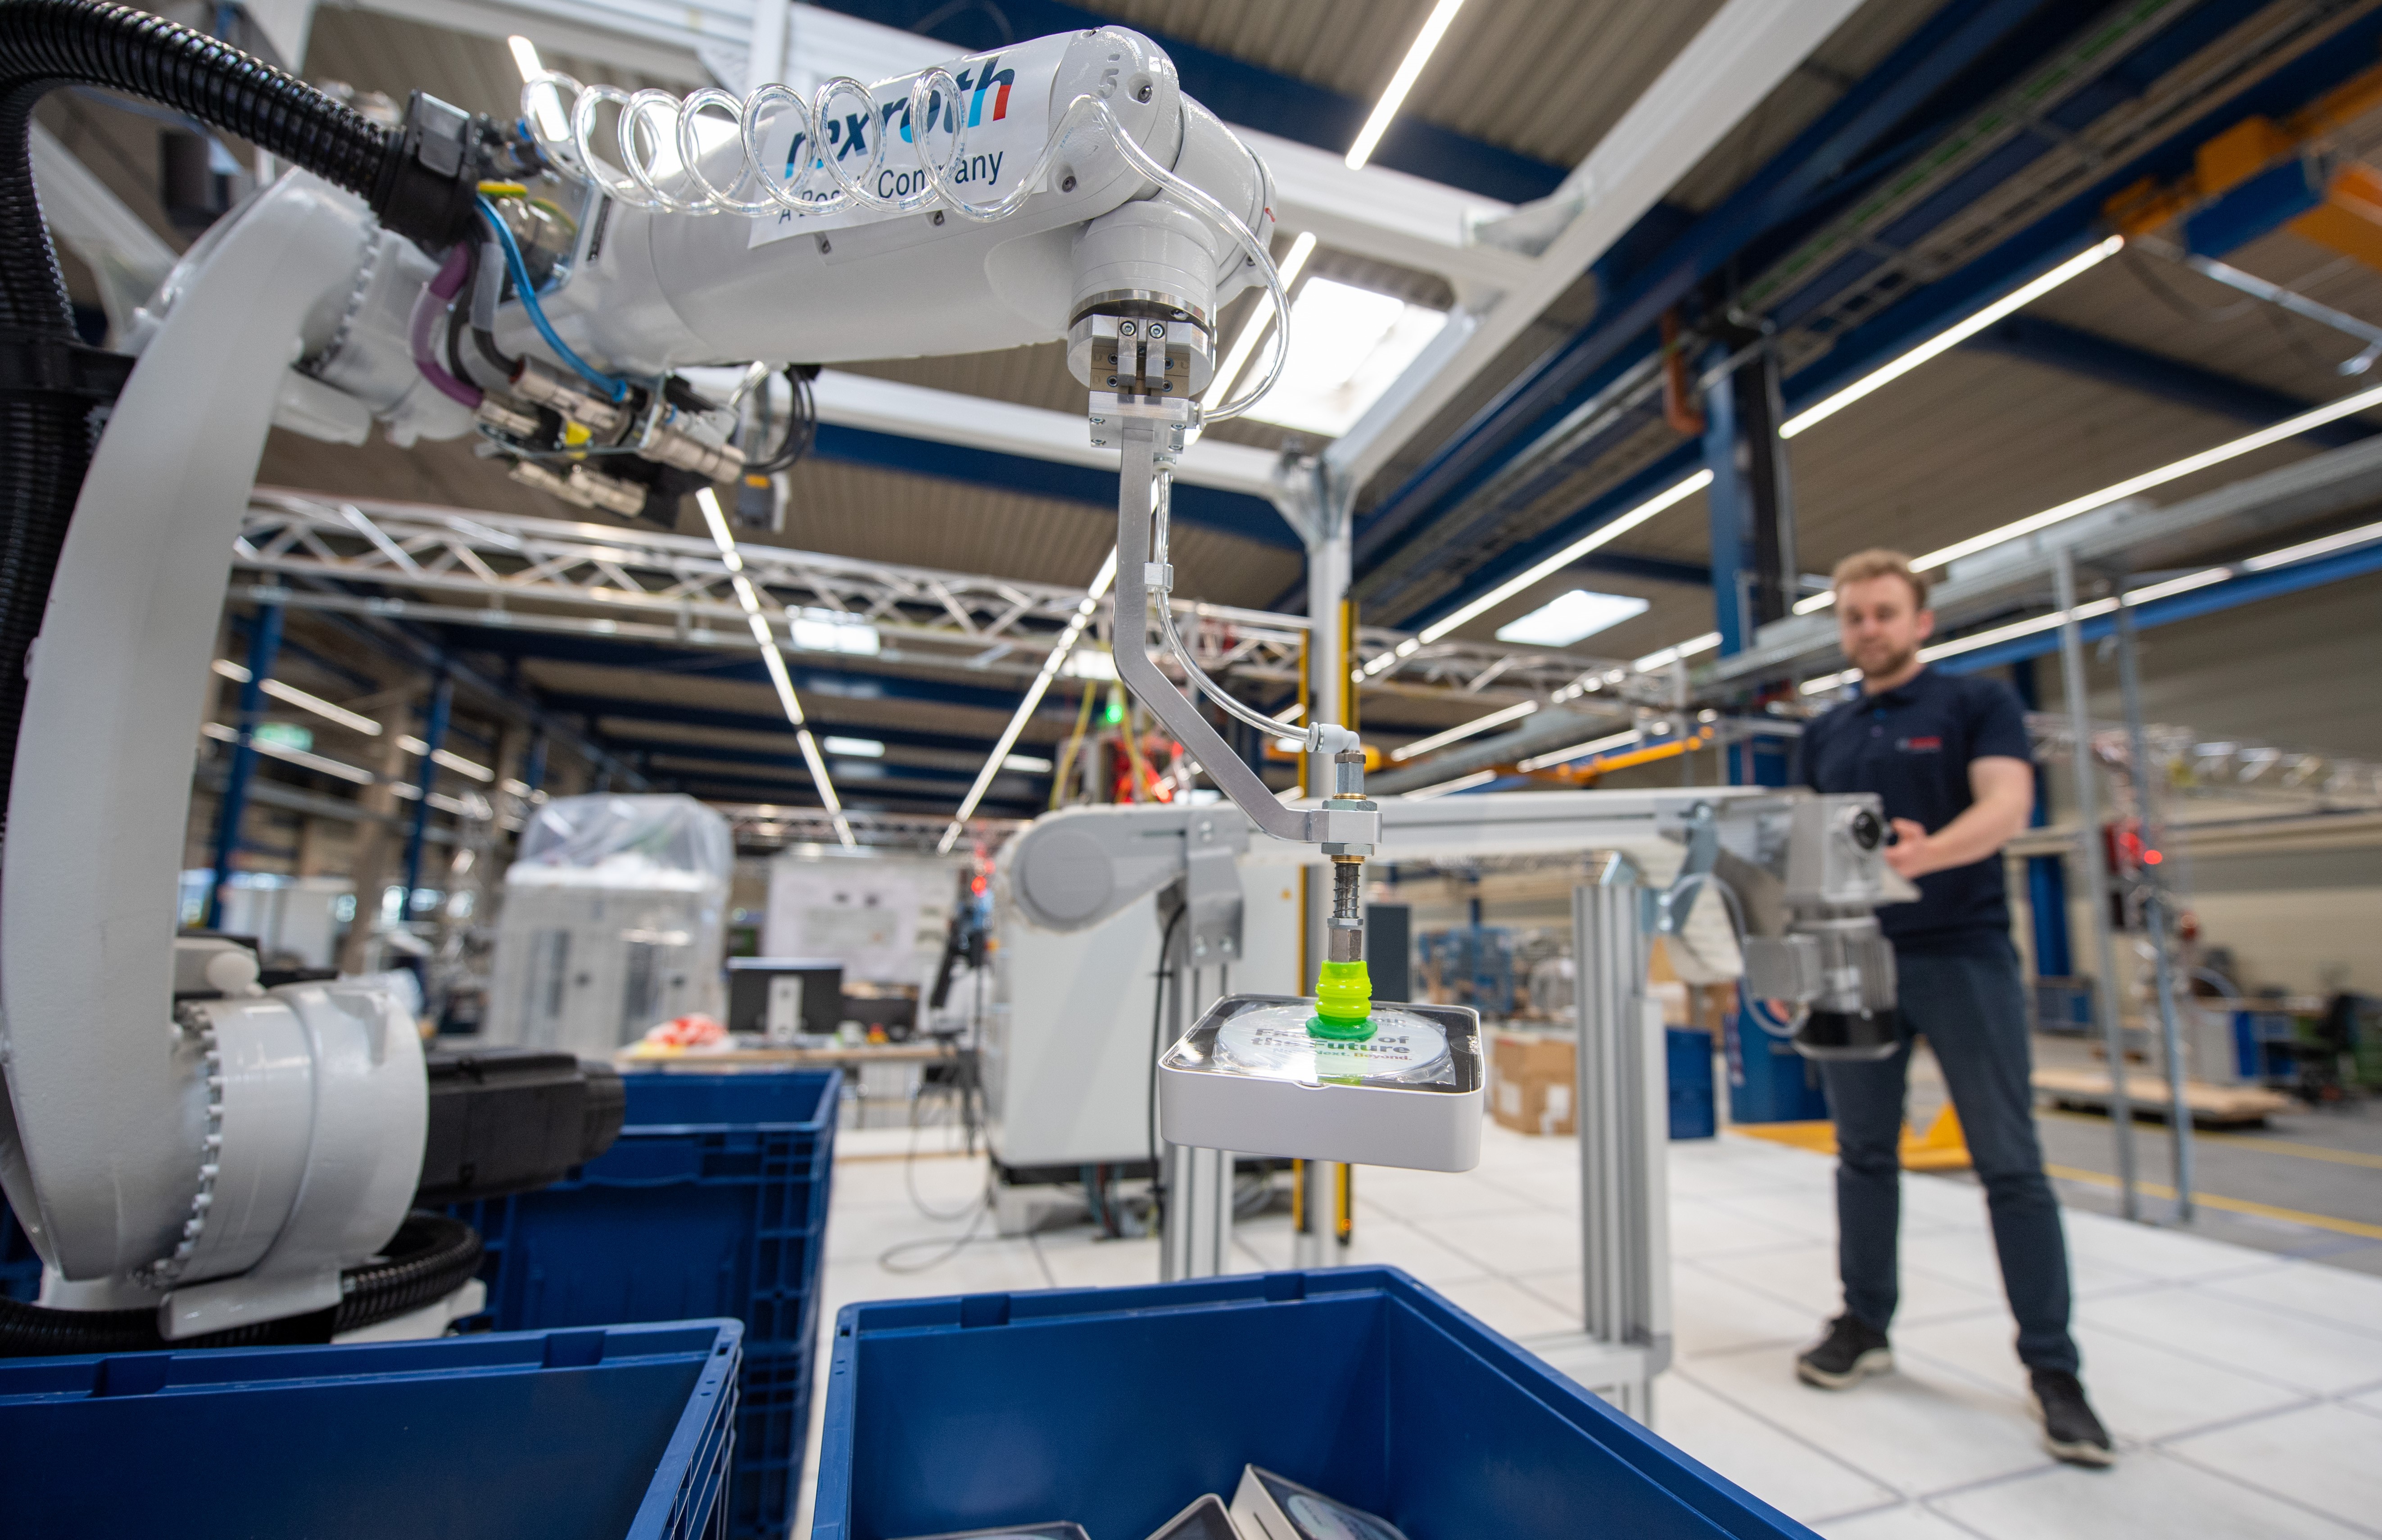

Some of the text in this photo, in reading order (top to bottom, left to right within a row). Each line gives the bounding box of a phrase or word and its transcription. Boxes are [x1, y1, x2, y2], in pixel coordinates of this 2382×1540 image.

[784, 56, 1015, 179] rexroth
[878, 151, 1003, 199] Comany
[1309, 1039, 1410, 1053] Future
[1378, 1036, 1409, 1044] of
